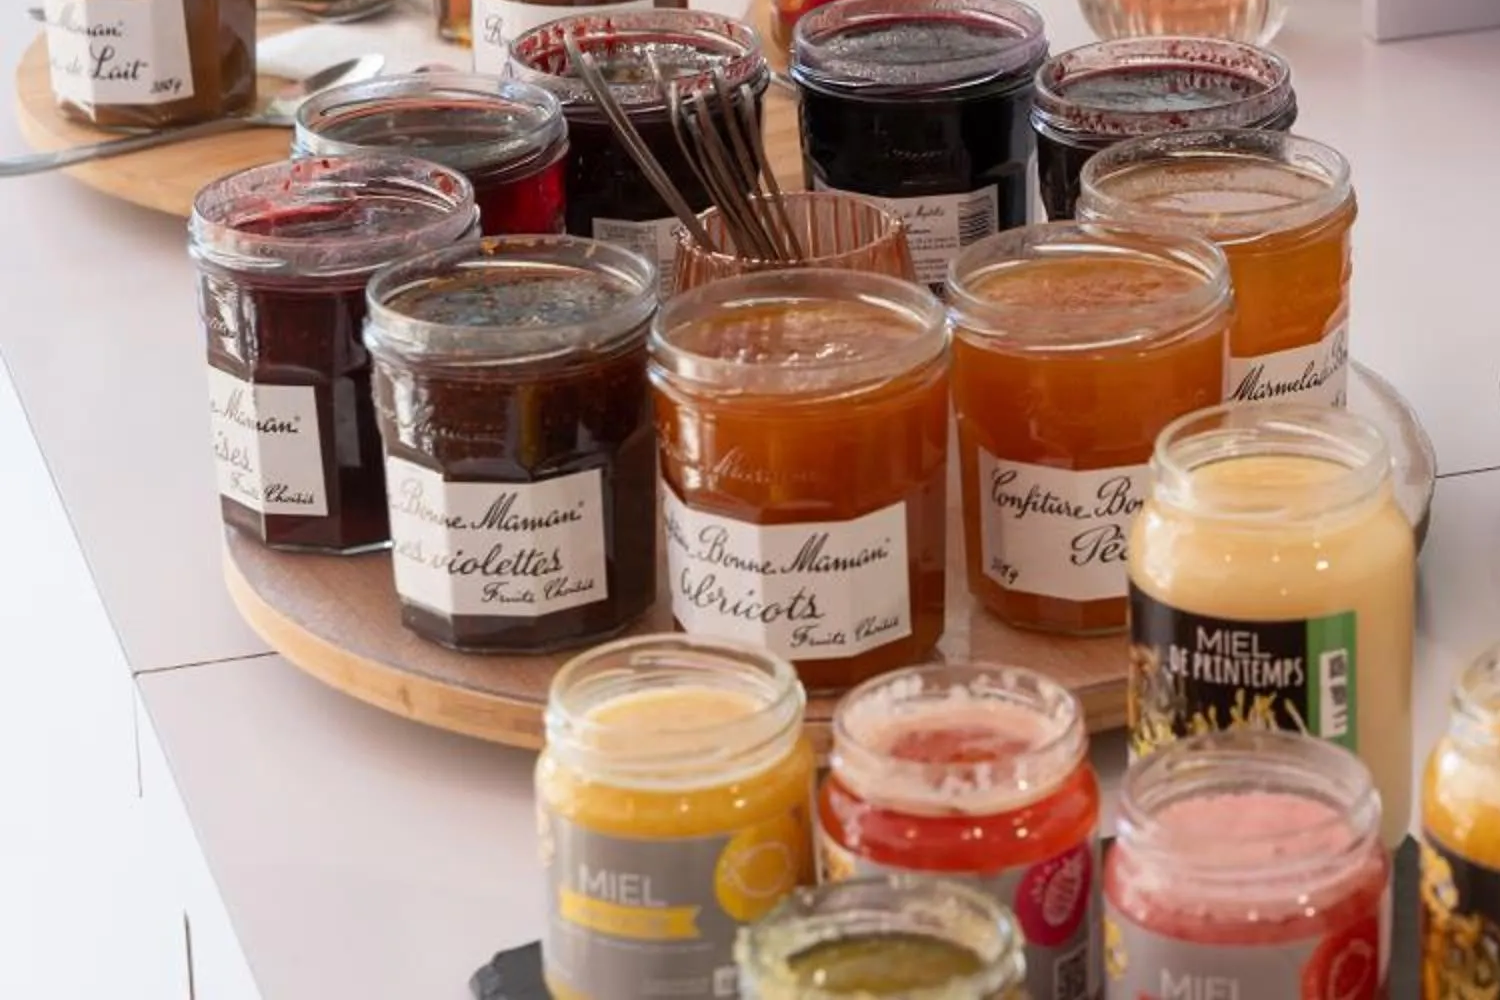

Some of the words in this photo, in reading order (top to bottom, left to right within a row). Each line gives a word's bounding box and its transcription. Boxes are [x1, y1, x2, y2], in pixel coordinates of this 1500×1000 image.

[88, 45, 150, 82] Lait
[471, 492, 586, 532] Maman
[990, 468, 1092, 519] Confiture
[430, 543, 565, 578] violettes
[690, 523, 778, 576] Bonne
[780, 532, 891, 576] Maman
[481, 581, 535, 604] Fruits
[680, 566, 826, 624] Abricots
[789, 623, 847, 649] Fruits
[1196, 625, 1272, 660] MIEL
[1168, 643, 1190, 678] DE
[1192, 652, 1305, 689] PRINTEMPS
[577, 862, 670, 909] MIEL
